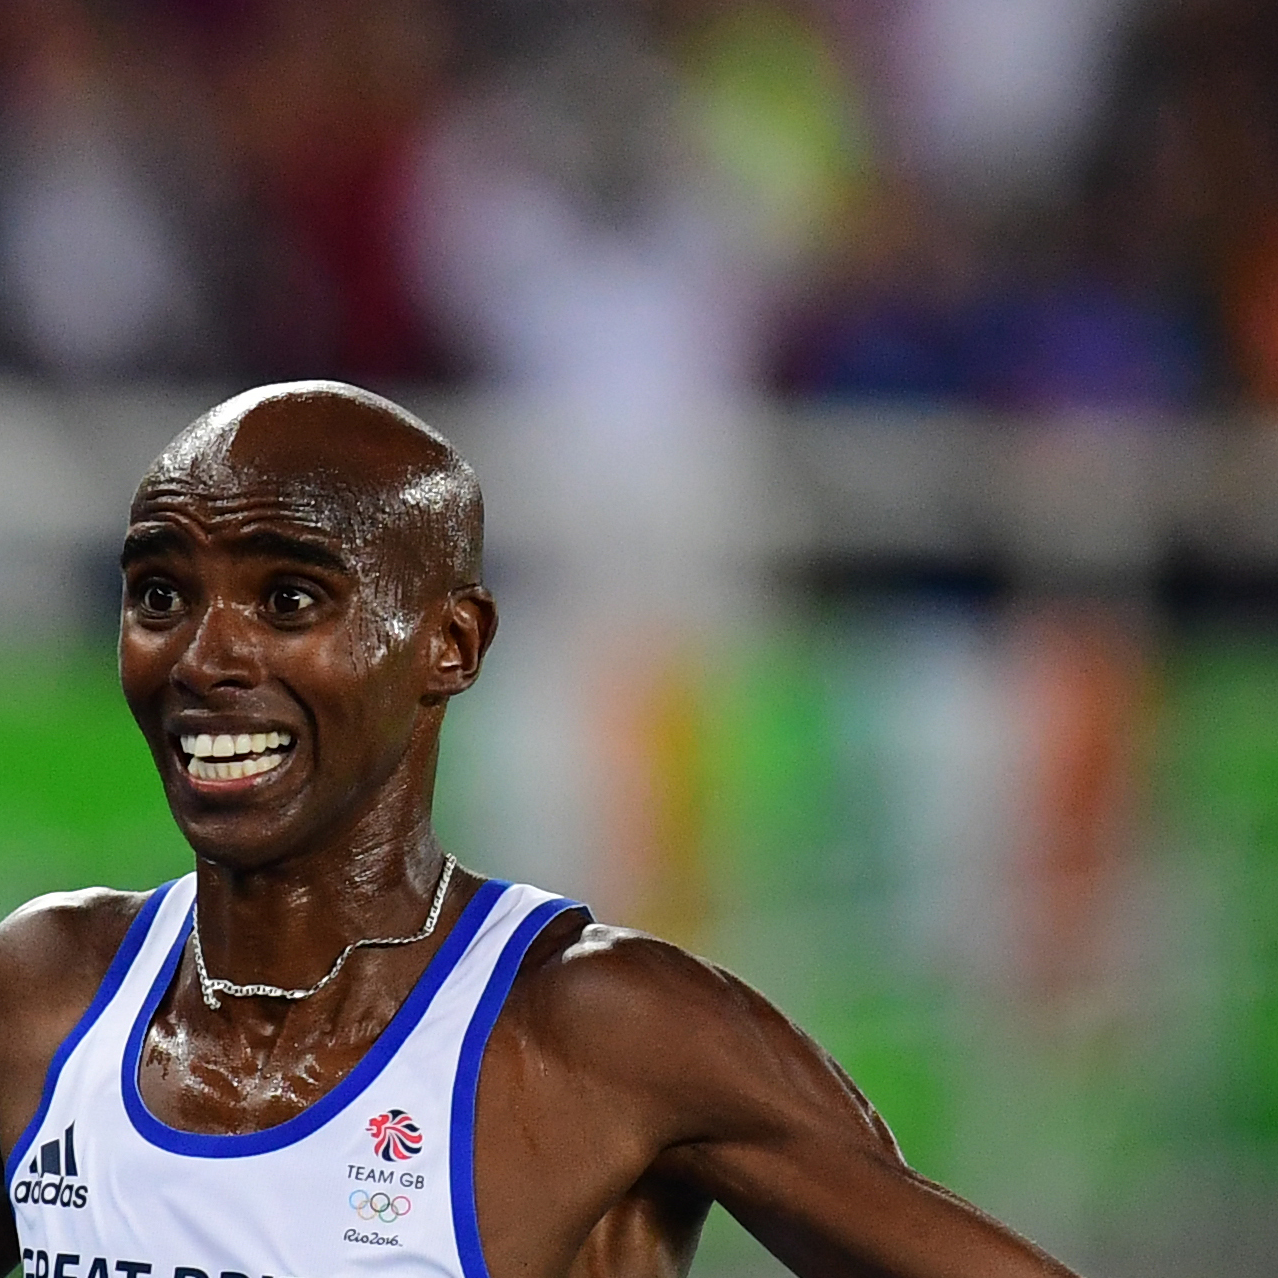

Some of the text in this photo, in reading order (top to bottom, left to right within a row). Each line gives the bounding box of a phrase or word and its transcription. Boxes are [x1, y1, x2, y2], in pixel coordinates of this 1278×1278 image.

[347, 1164, 425, 1190] TEAM GB
[14, 1176, 88, 1209] addas
